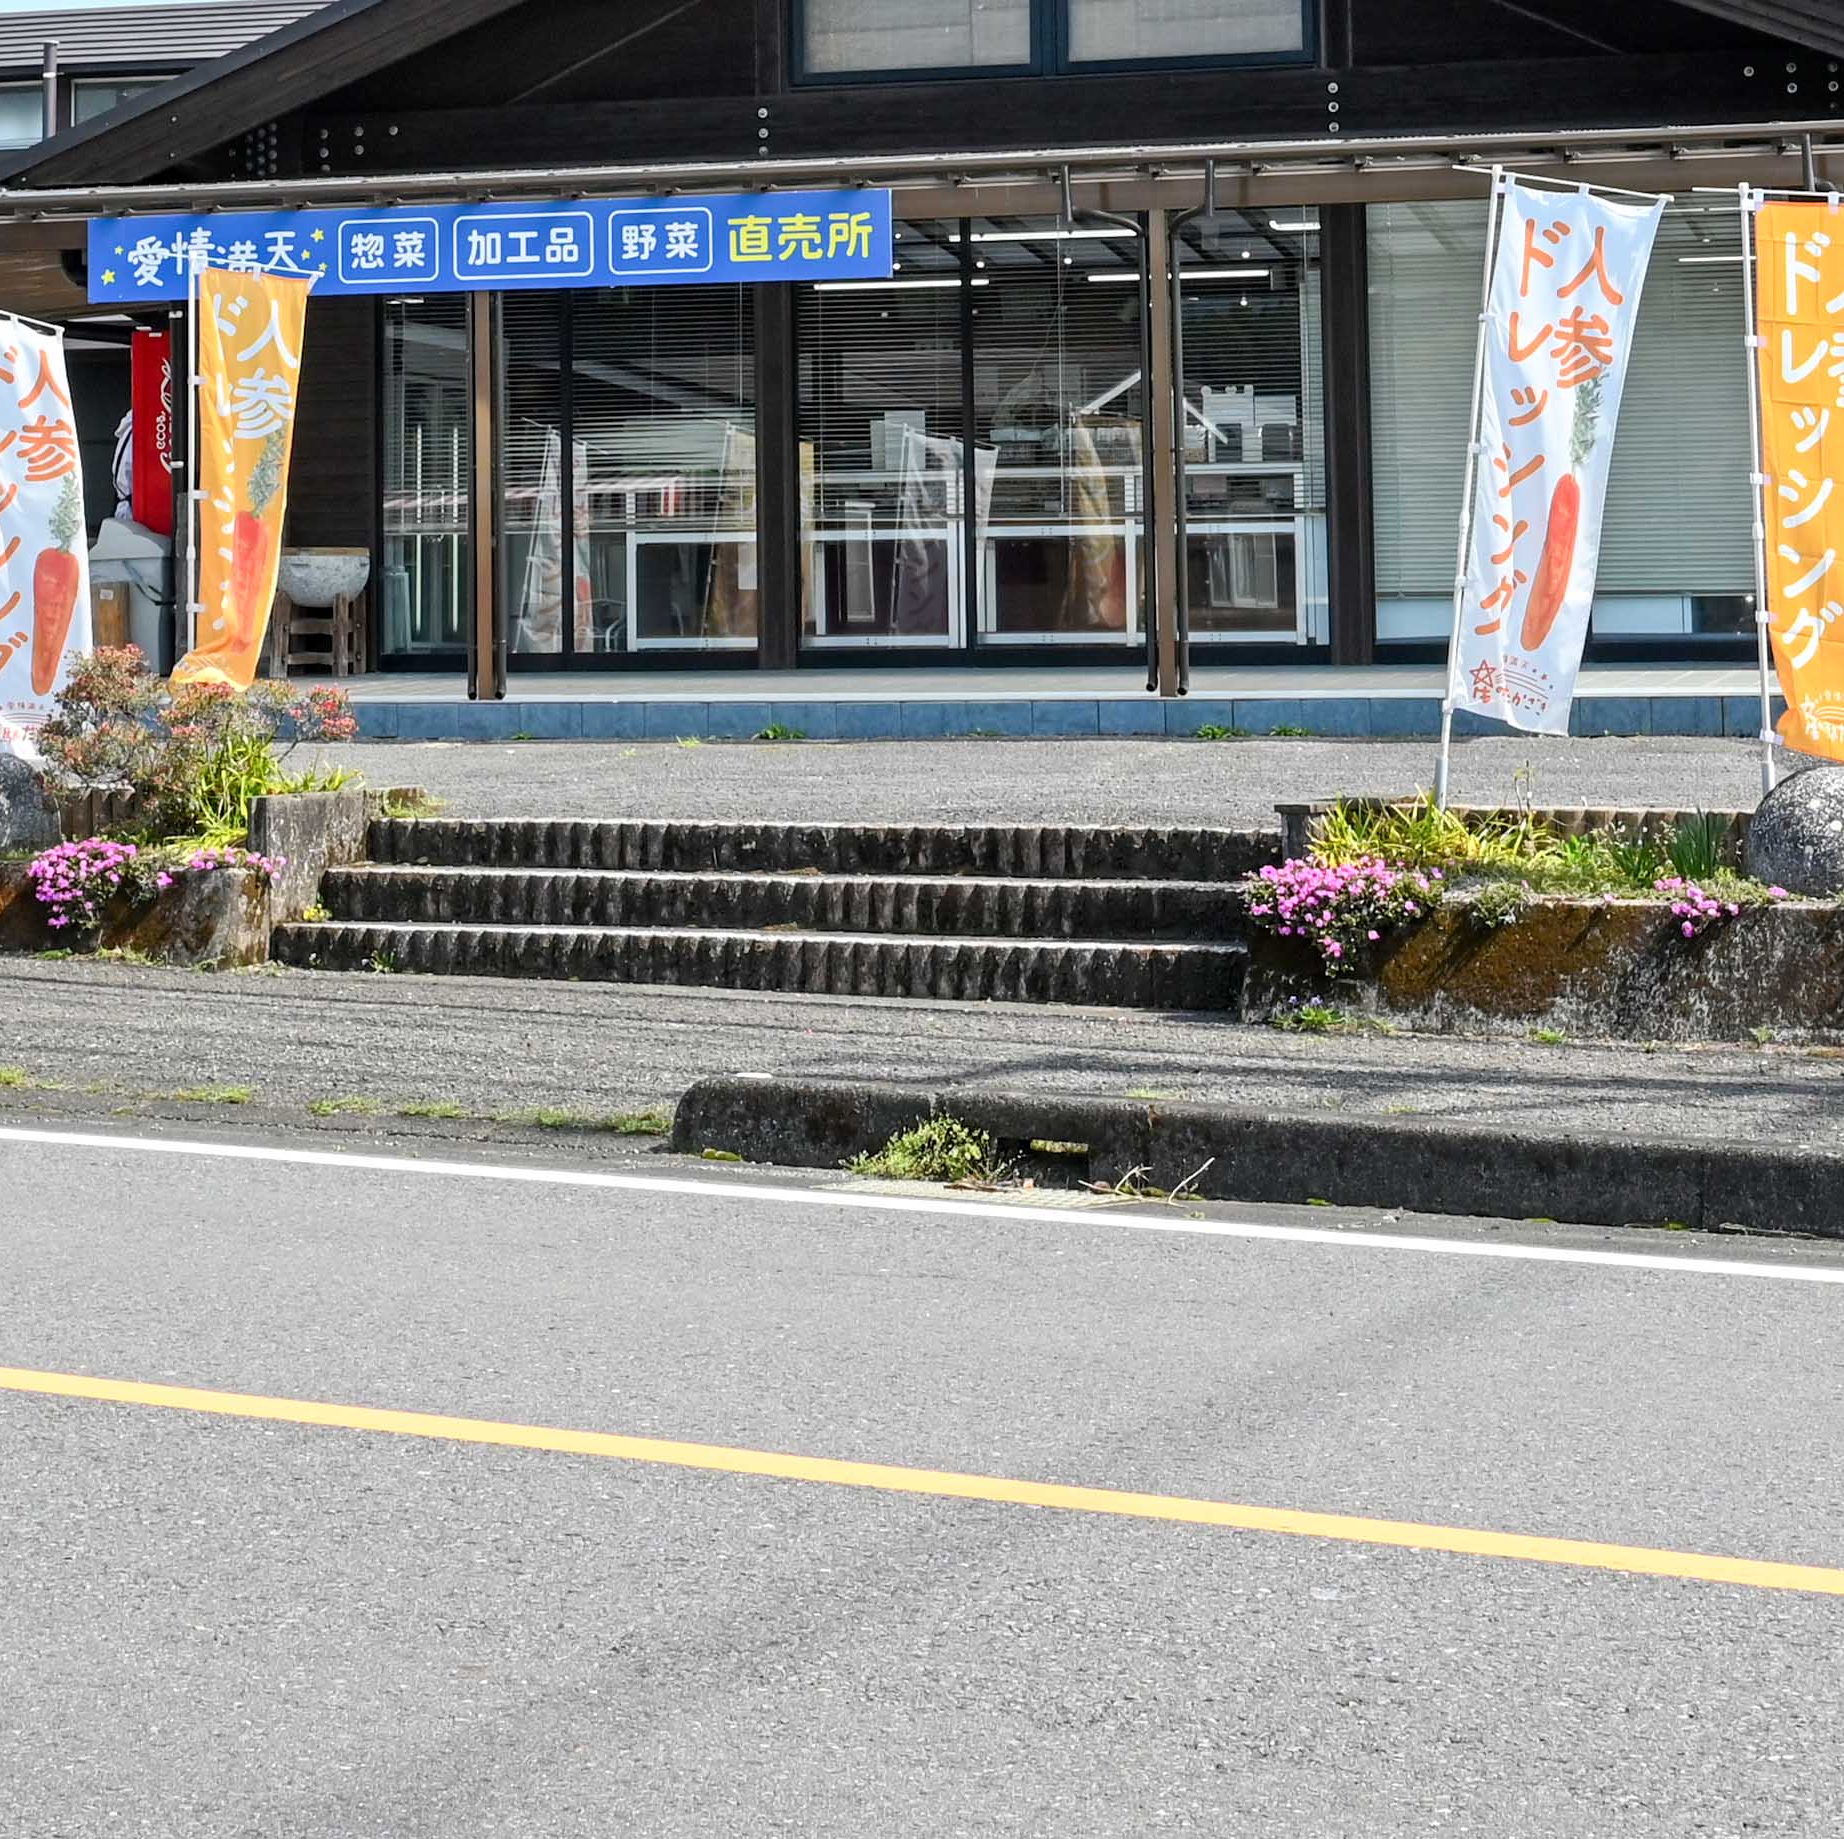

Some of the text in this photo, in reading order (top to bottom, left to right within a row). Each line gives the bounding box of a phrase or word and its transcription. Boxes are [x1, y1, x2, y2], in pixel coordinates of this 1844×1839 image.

[127, 212, 874, 288] 愛情満天 惣菜 加工品 野菜 直売所
[1550, 225, 1625, 389] 人参
[16, 348, 77, 482] 人参
[229, 298, 299, 441] 人参
[1474, 218, 1571, 637] ドレッシング
[1778, 232, 1844, 670] ドレッシング
